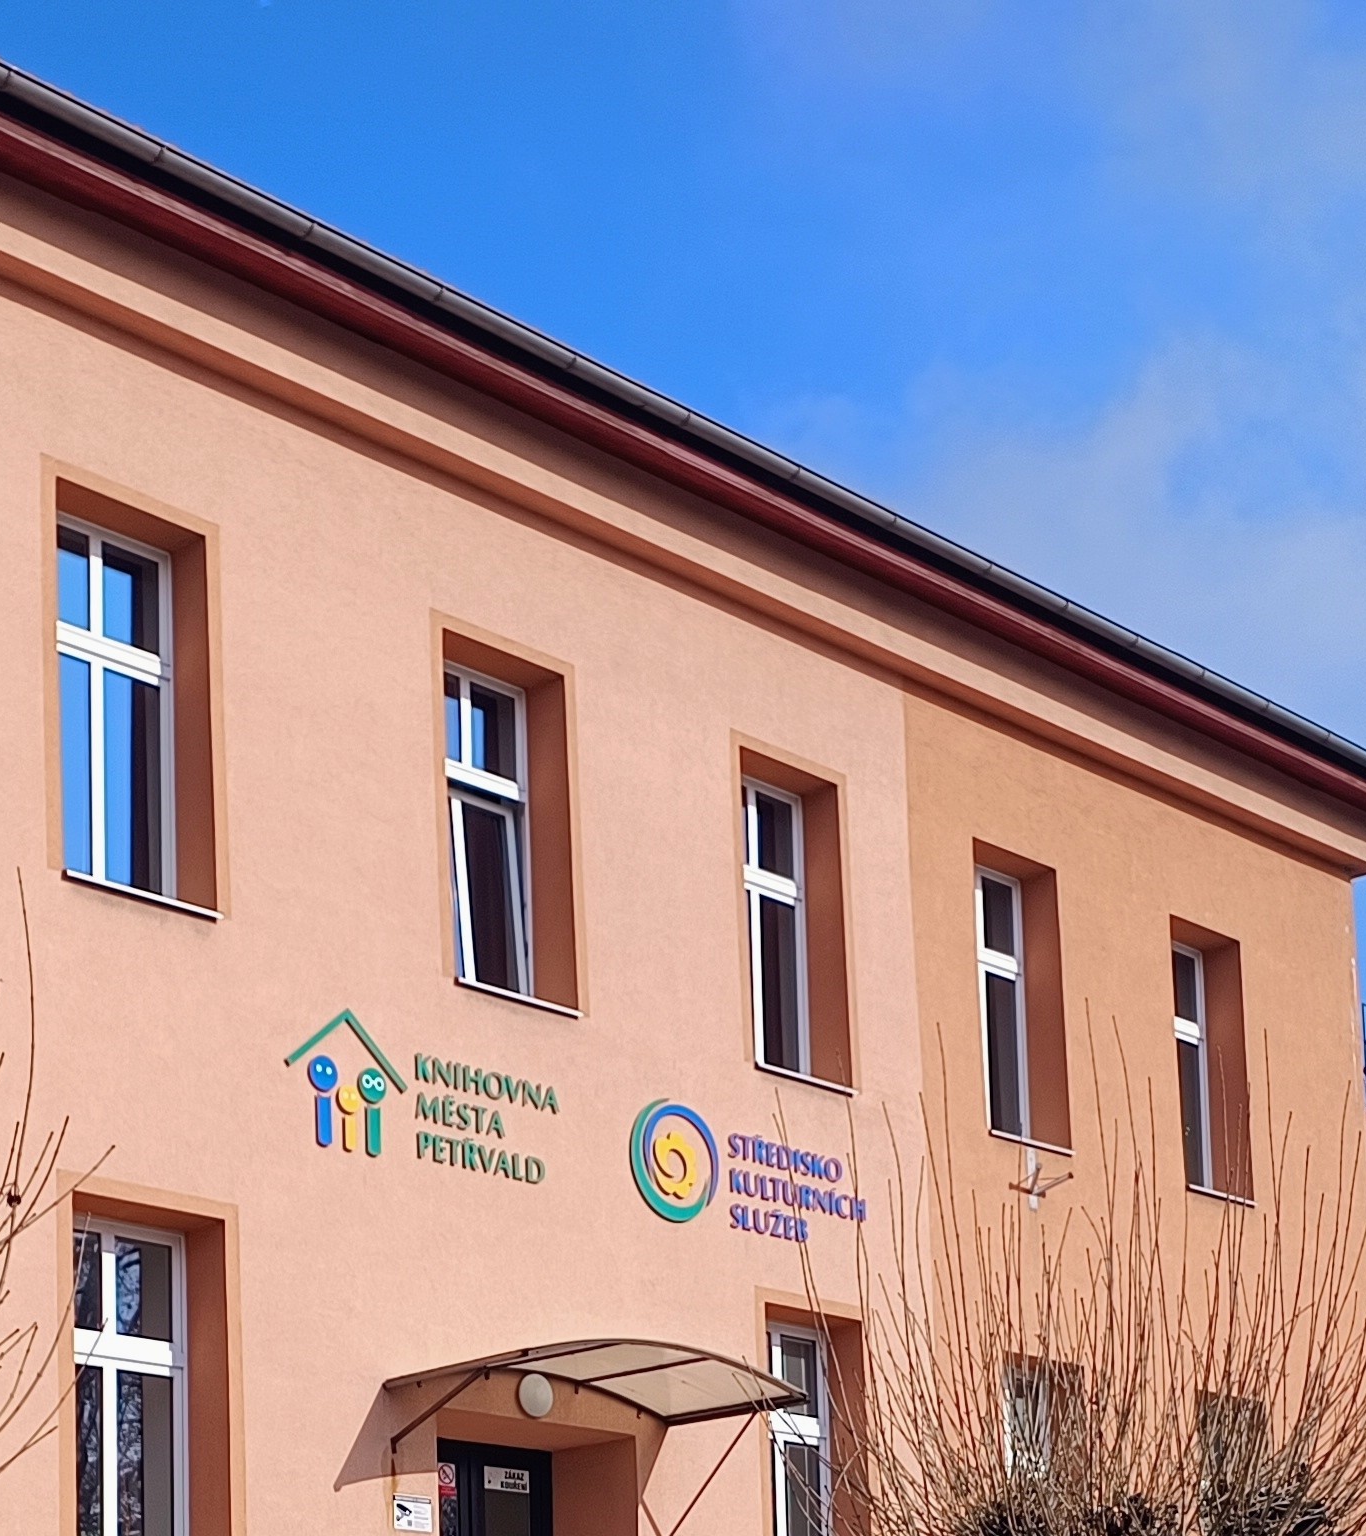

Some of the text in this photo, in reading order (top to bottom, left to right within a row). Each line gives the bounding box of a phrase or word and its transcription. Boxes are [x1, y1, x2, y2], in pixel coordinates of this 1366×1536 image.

[414, 1053, 560, 1115] KNIHOVNA
[415, 1092, 505, 1139] MĚSTA
[416, 1131, 546, 1185] PETŘVALD
[727, 1132, 843, 1183] STŘEDISKO
[729, 1167, 867, 1223] KULTURNÍCH
[729, 1203, 809, 1243] SLUŽEB
